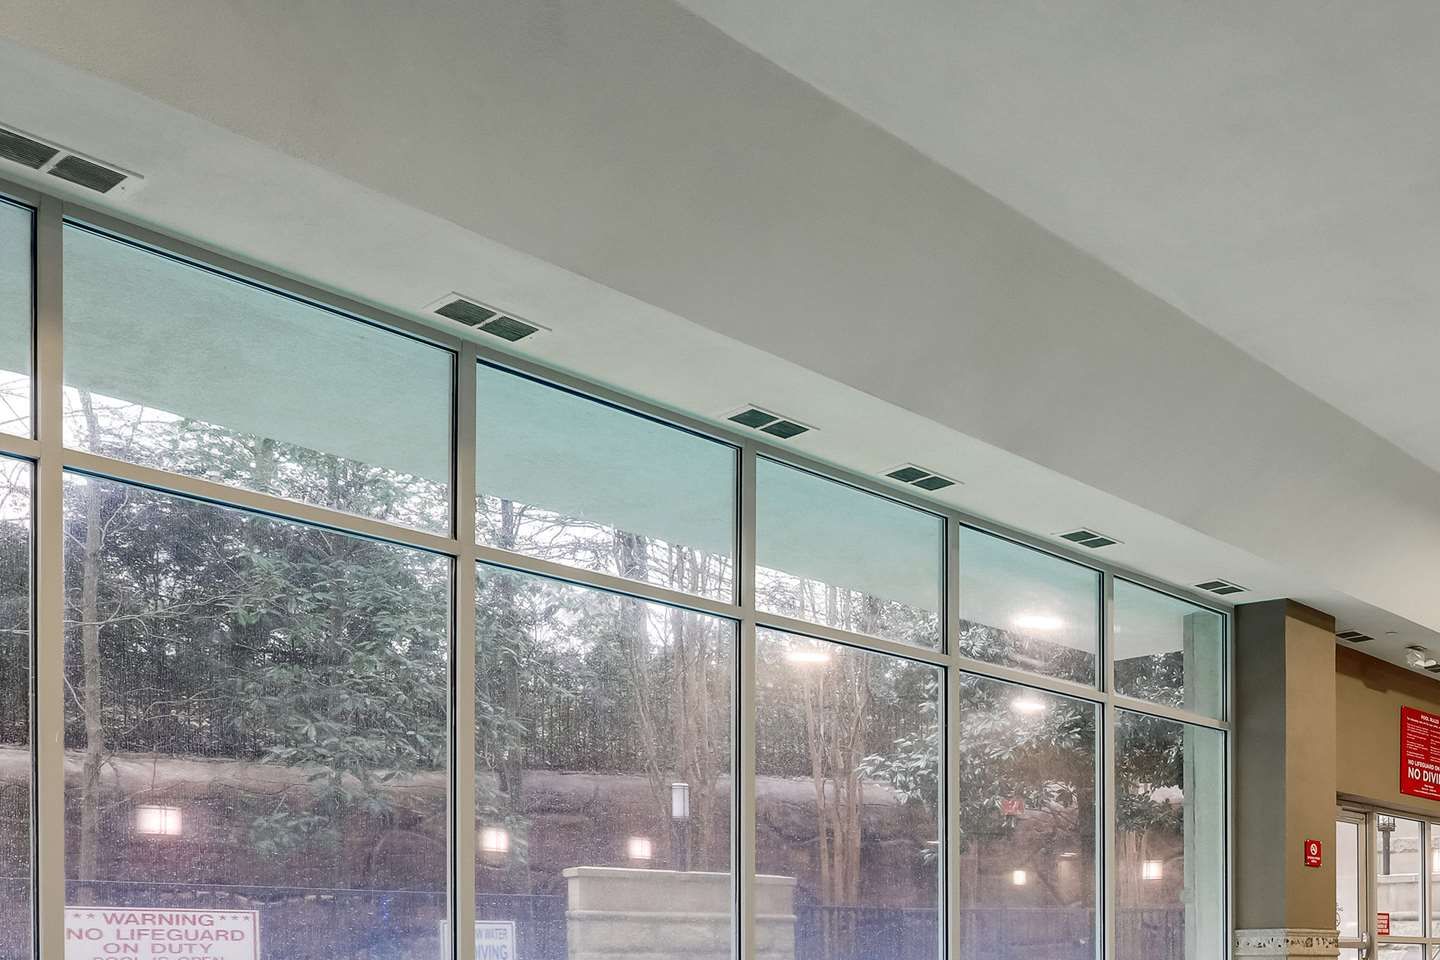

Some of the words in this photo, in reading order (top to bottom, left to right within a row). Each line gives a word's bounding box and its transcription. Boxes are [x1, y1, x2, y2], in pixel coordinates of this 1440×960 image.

[1408, 766, 1421, 780] NO
[103, 913, 214, 927] WARNING
[65, 928, 103, 941] NO
[116, 928, 245, 942] LIFEGUARD
[103, 943, 138, 953] ON
[151, 943, 213, 954] DUTY
